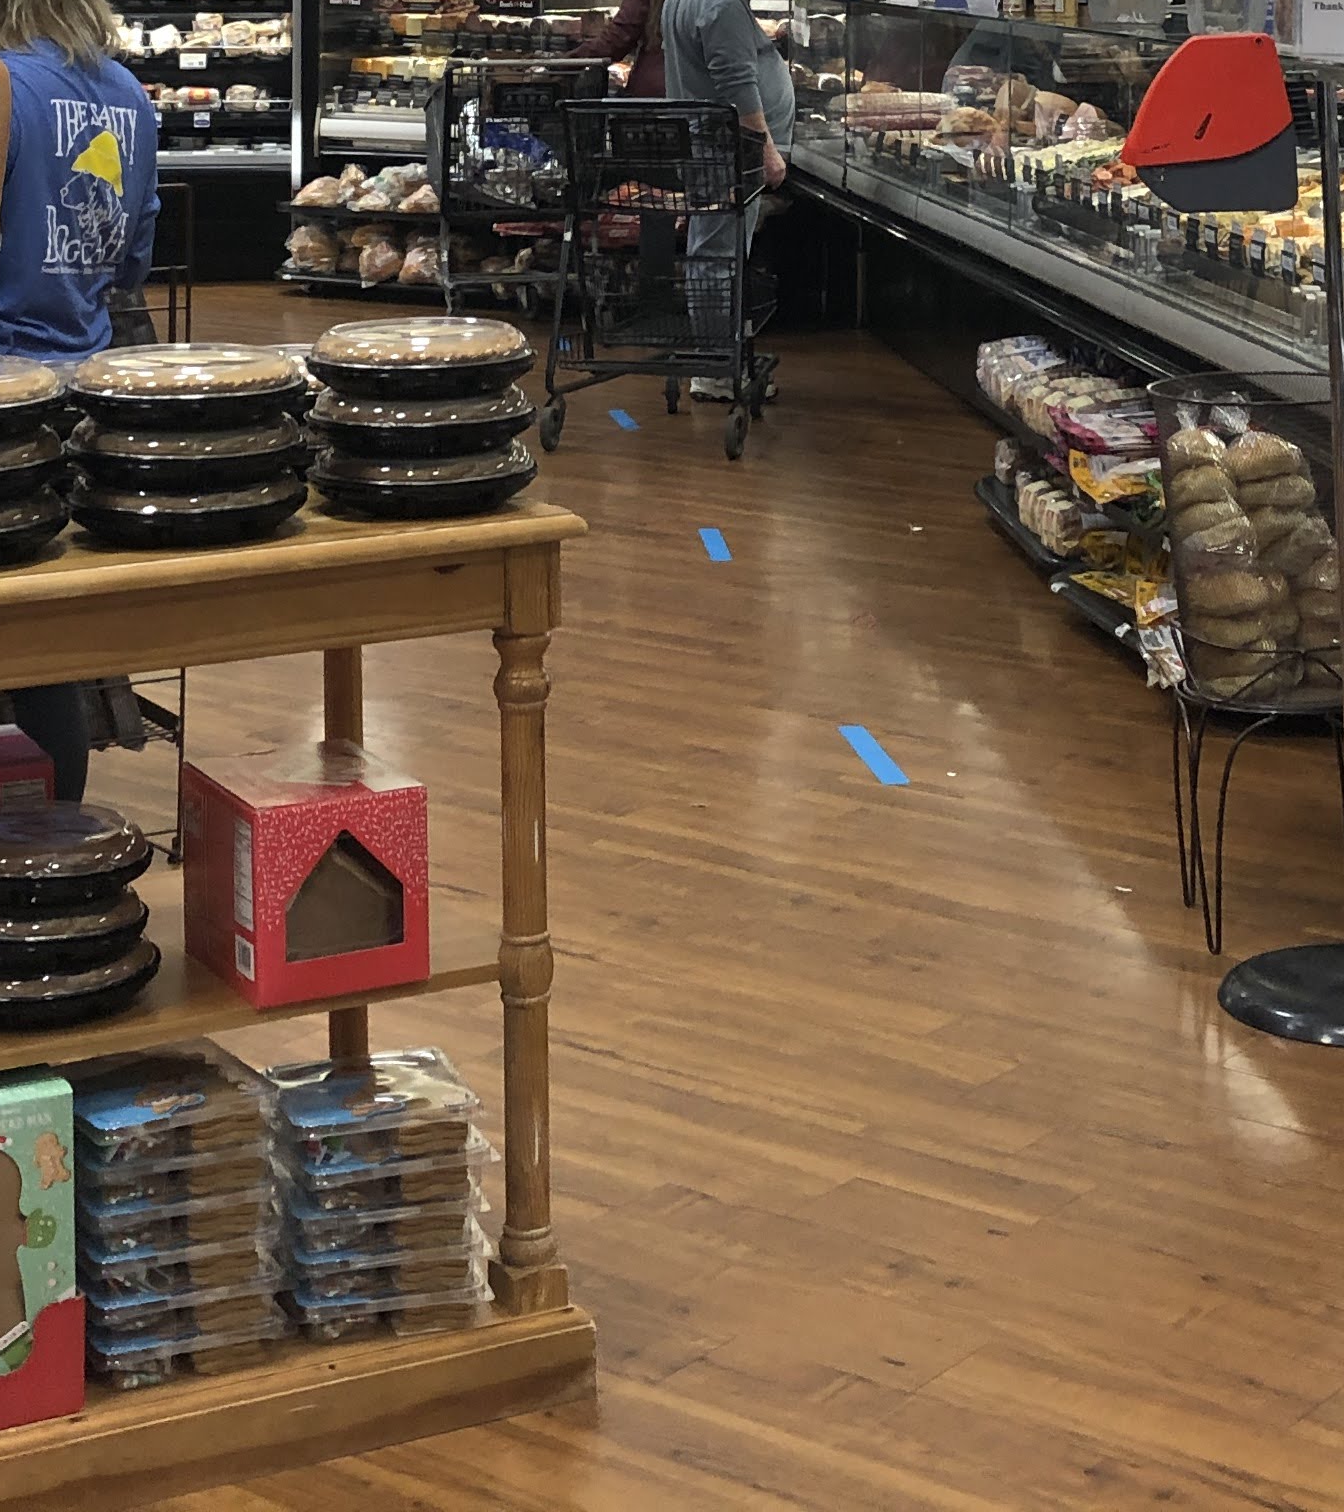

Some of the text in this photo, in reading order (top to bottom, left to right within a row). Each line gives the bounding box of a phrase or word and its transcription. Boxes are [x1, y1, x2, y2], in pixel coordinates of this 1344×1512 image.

[1312, 1, 1344, 11] Thank
[50, 99, 138, 166] THE SALTY
